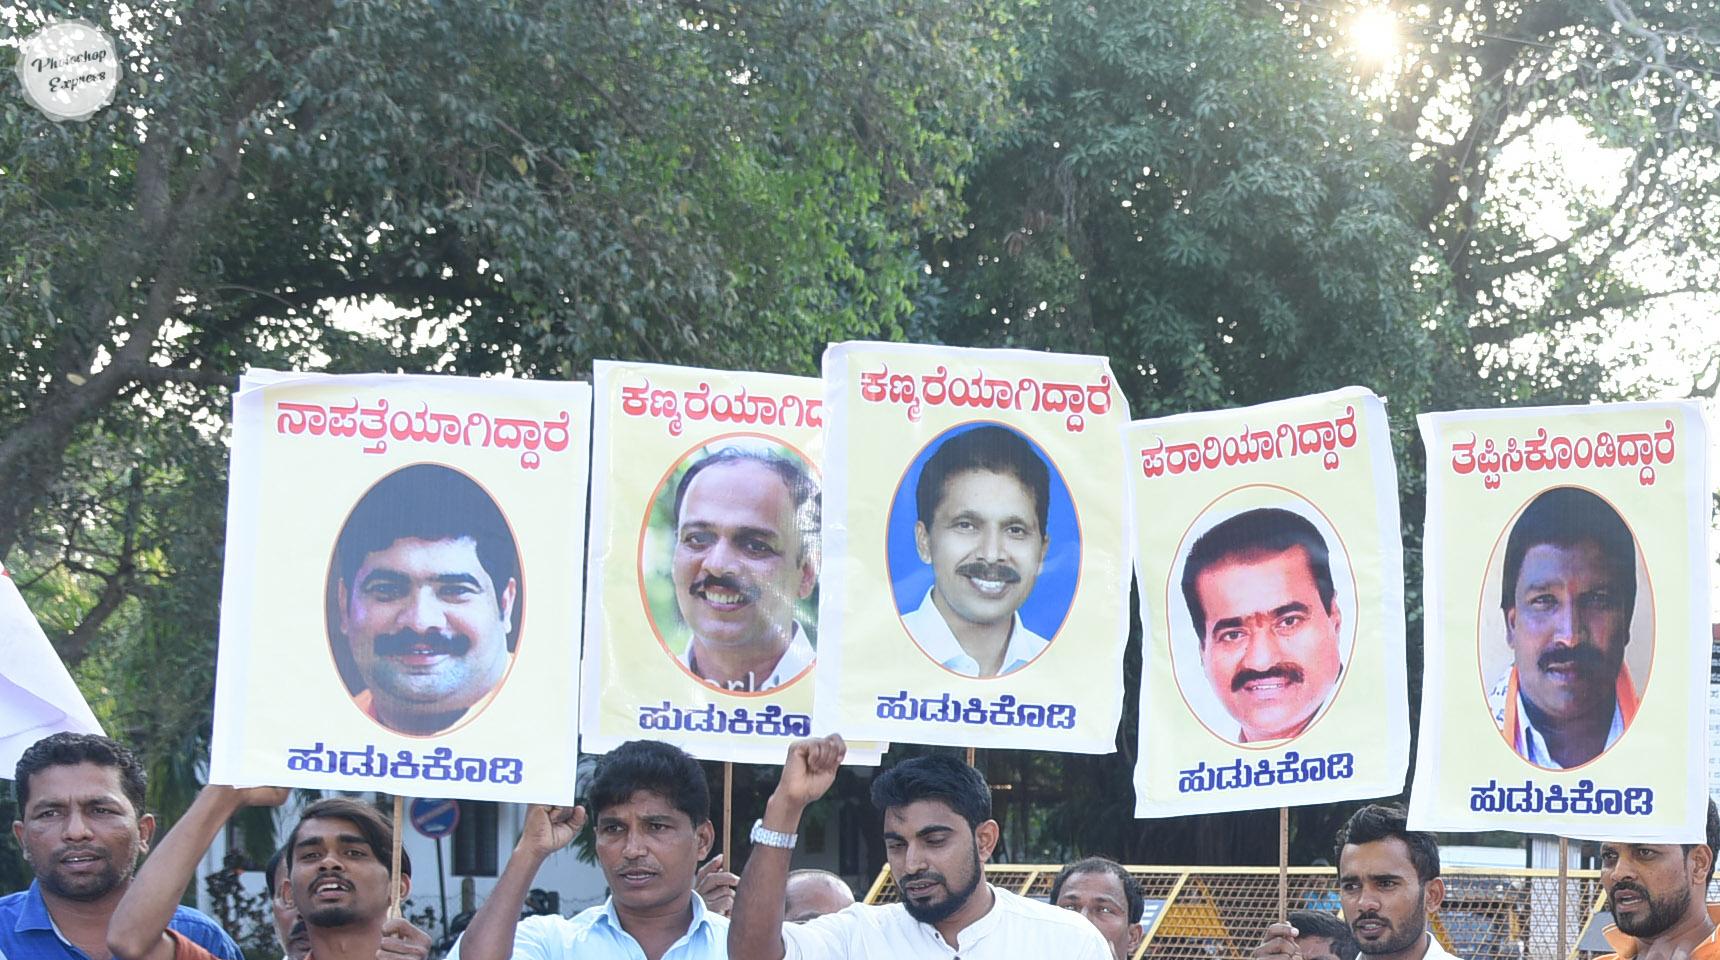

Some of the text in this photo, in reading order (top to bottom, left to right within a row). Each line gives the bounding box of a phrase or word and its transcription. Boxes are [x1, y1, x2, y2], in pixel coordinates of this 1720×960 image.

[860, 363, 1112, 432] ಕಣ್ಮರೆಯಾಗಿದ್ದಾರೆ
[277, 397, 570, 470] ನಾಪತ್ತೆಯಾಗಿದ್ದಾರೆ
[1141, 405, 1358, 478] ಪರಾರಿಯಾಗಿದ್ದಾರೆ
[1451, 419, 1675, 490] ತಪ್ಪಿಸಿಕೊಂಡಿದ್ದಾರೆ
[639, 700, 811, 738] ಹುಡುಕಿಕೊ
[876, 690, 1076, 730] ಹುಡುಕಿಕೊಡಿ
[287, 741, 524, 785] ಹುಡುಕಿಕೊಡಿ
[1178, 750, 1354, 793] ಹುಡುಕಿಕೊಡಿ
[1469, 779, 1654, 816] ಹುಡುಕಿಕೊಡಿ
